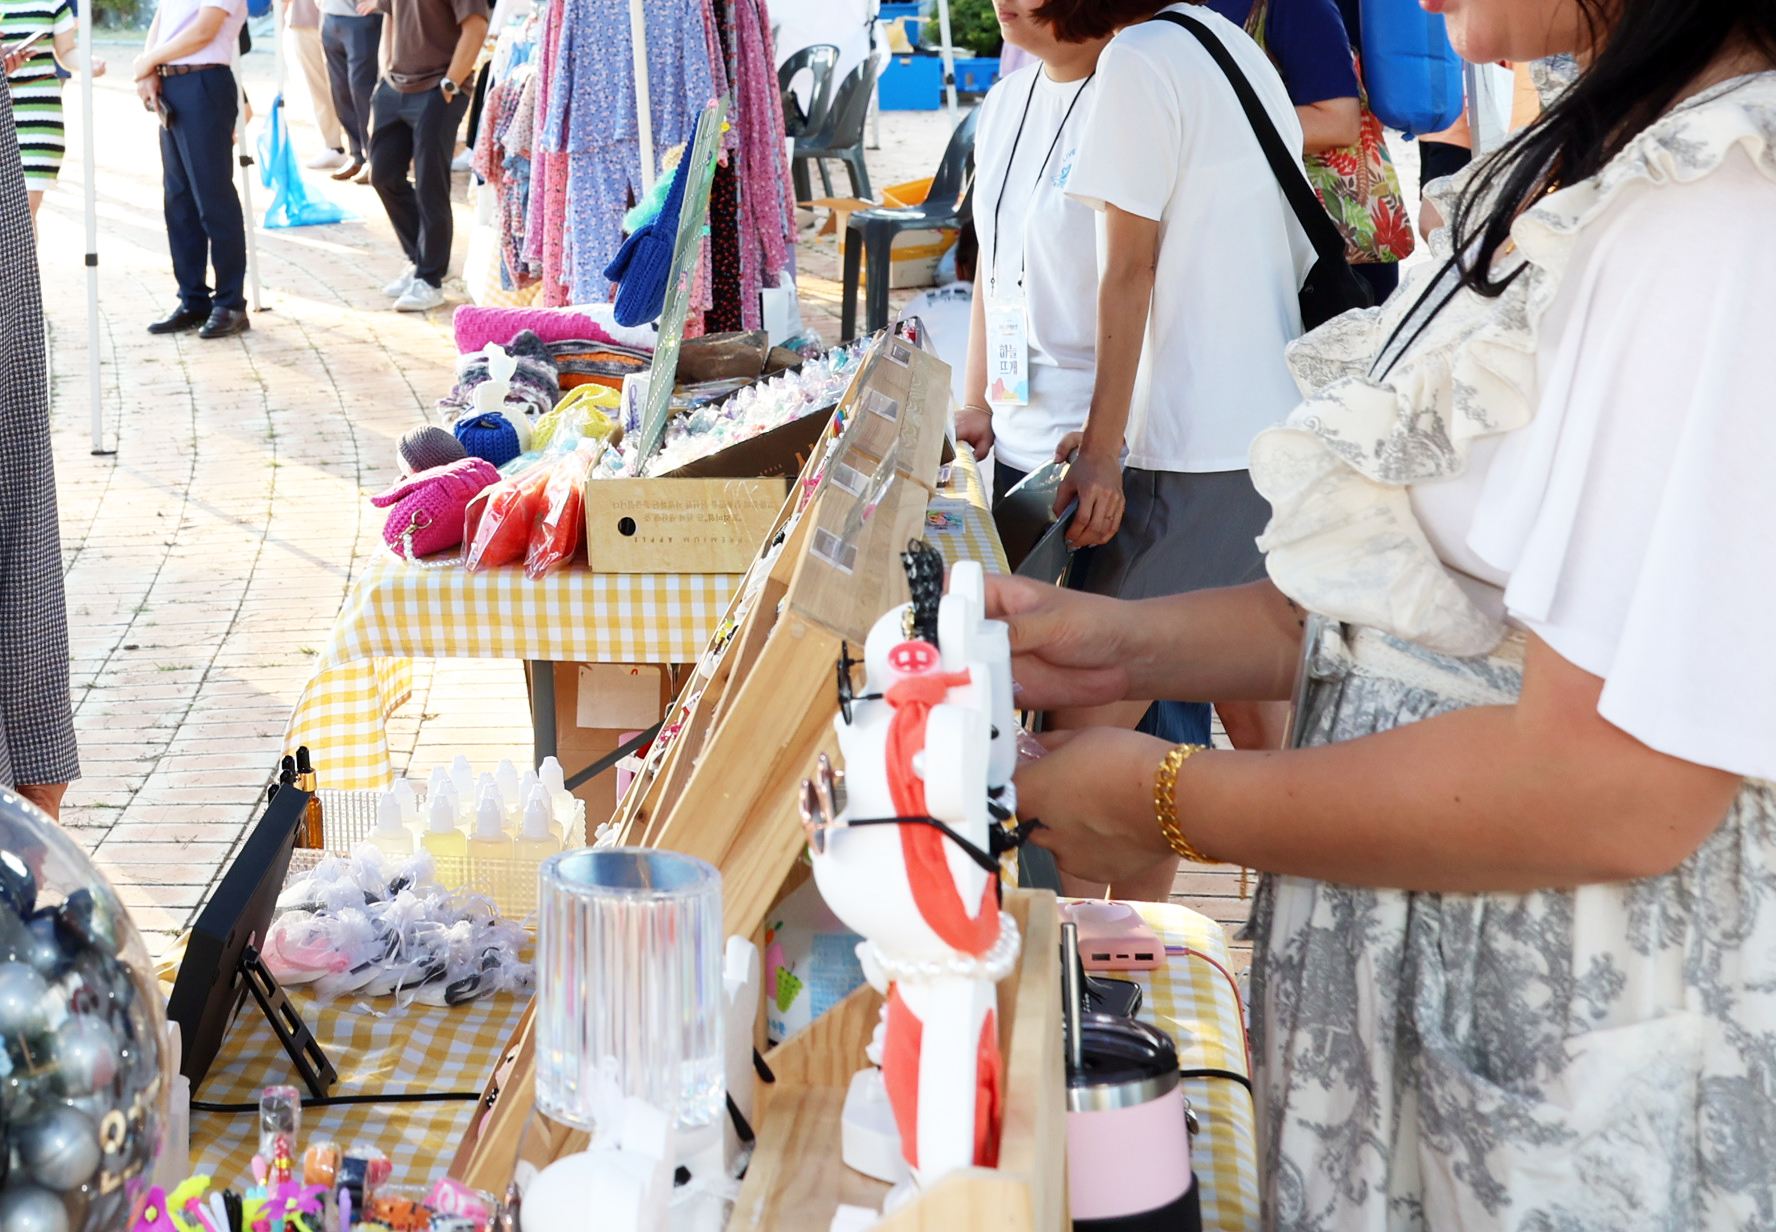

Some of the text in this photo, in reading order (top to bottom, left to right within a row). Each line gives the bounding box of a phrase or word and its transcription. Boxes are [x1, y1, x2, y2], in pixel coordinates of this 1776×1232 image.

[999, 344, 1017, 359] 하늘
[999, 361, 1018, 375] 뜨개
[633, 536, 743, 544] PREMIUM APPLE
